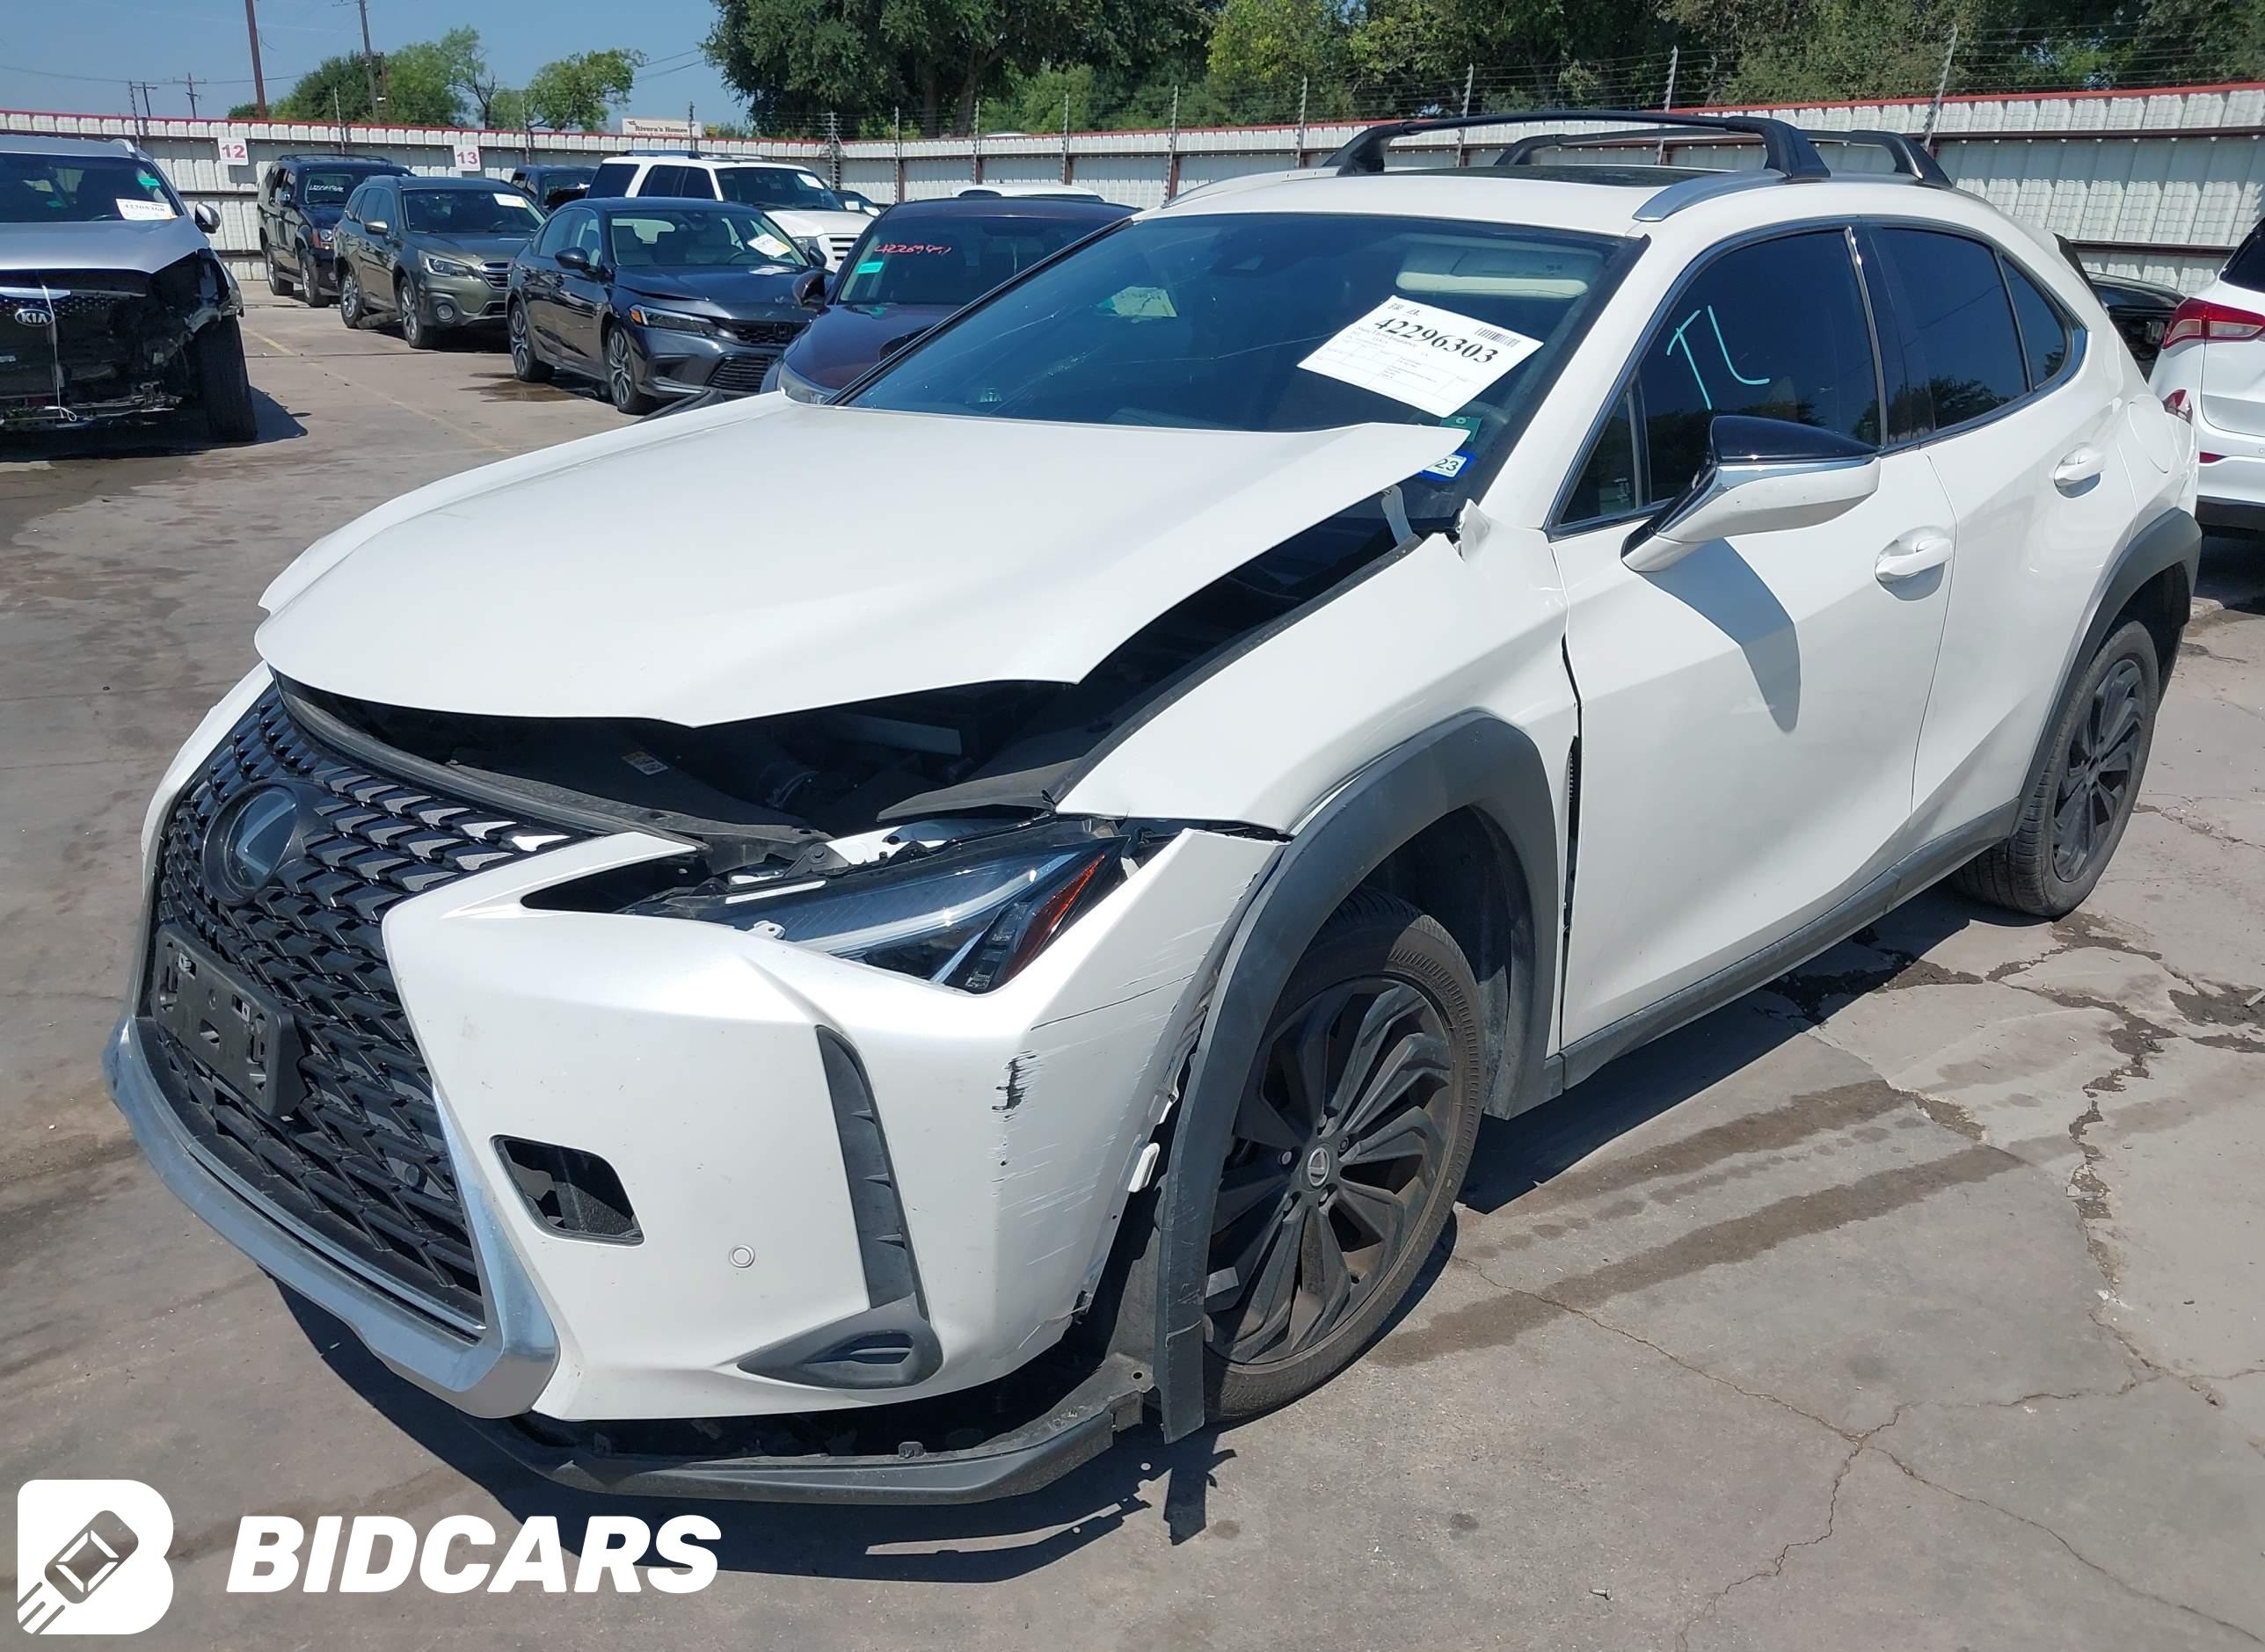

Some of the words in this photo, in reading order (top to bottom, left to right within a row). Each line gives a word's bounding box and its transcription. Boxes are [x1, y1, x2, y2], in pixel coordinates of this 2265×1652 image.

[222, 144, 246, 159] 12
[456, 151, 478, 164] 13
[21, 312, 48, 324] KIA
[1374, 317, 1498, 363] 42296303
[1434, 458, 1460, 471] 23
